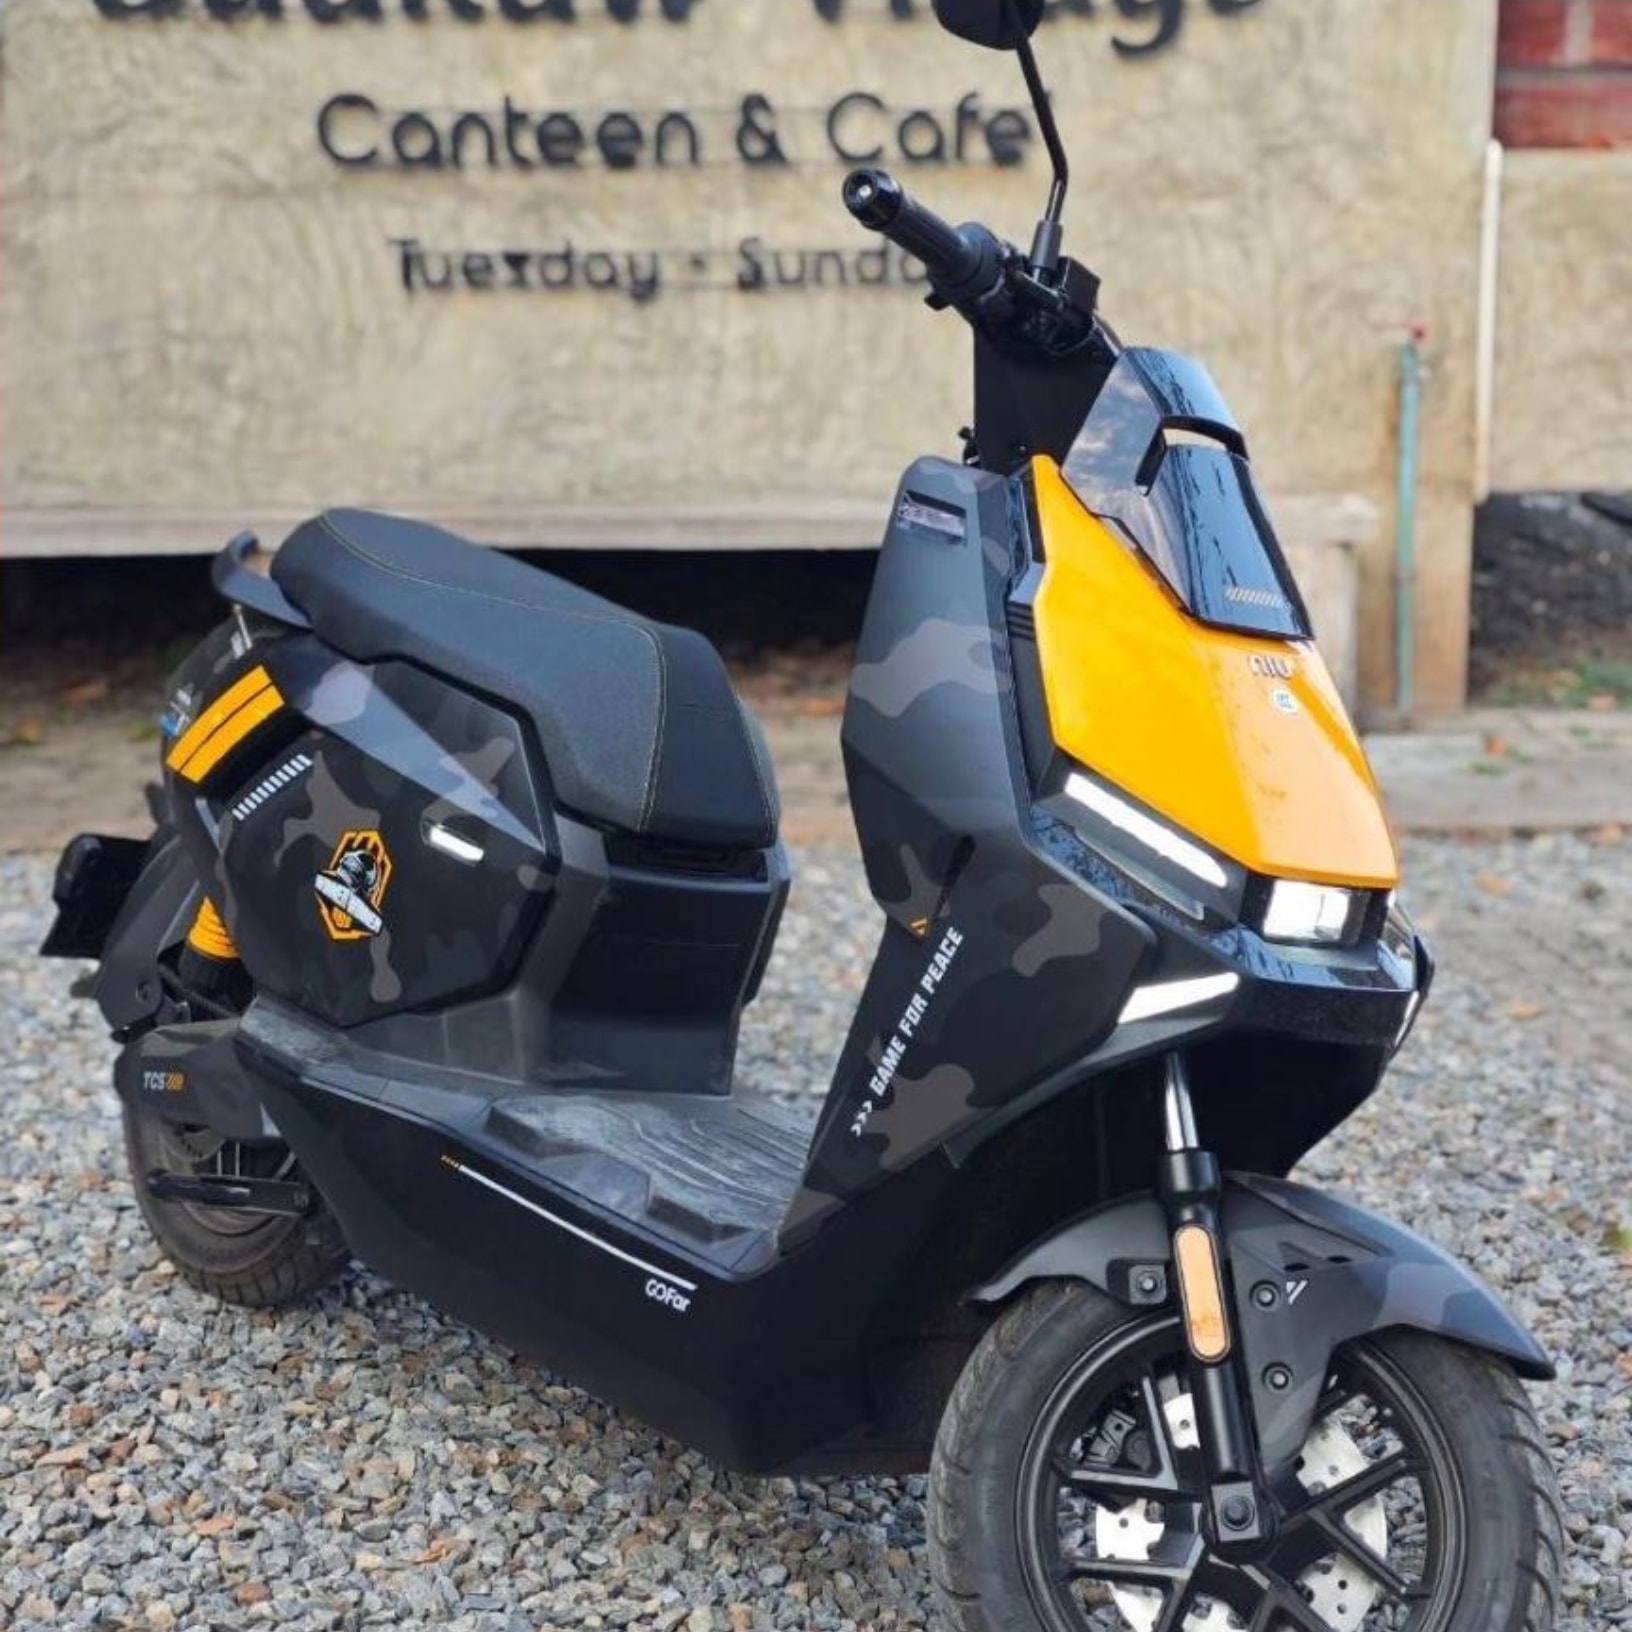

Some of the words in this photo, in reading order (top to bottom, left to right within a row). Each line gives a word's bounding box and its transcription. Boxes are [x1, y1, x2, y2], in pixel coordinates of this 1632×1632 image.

[318, 93, 700, 170] Canteen
[735, 93, 788, 166] &
[384, 237, 660, 303] Tuesday
[736, 236, 928, 291] Sunda
[869, 1035, 906, 1097] GAME
[897, 992, 929, 1038] FOR
[920, 926, 964, 995] PEACE
